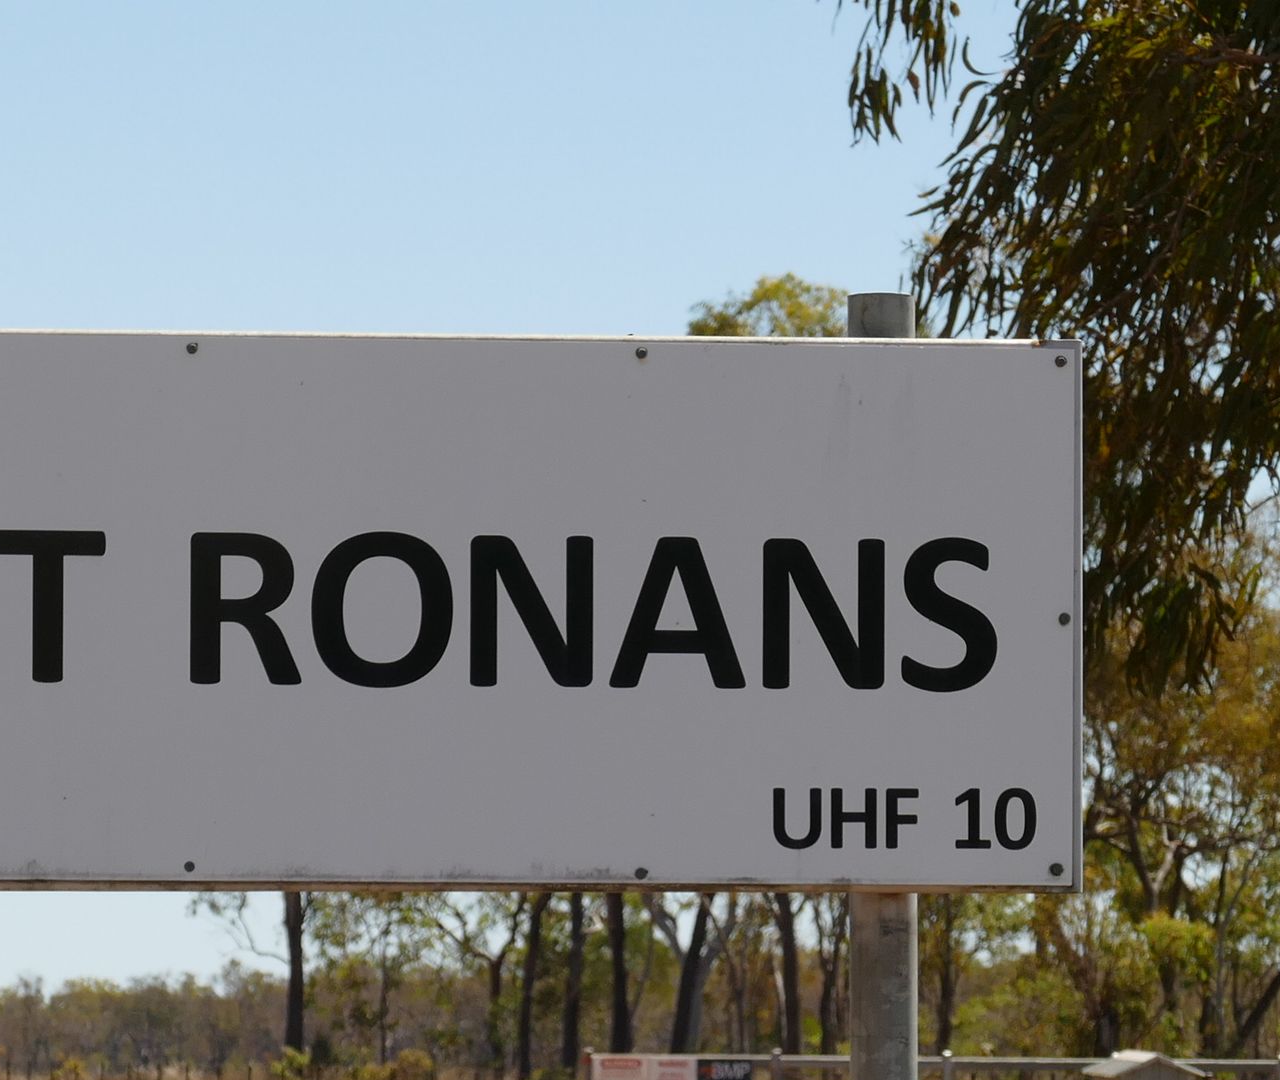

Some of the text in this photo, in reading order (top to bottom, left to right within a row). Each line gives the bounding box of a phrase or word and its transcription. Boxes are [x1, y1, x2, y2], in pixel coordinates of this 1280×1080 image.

[189, 530, 998, 694] RONANS
[772, 787, 1038, 851] UHF 10
[712, 1062, 751, 1080] BMP
